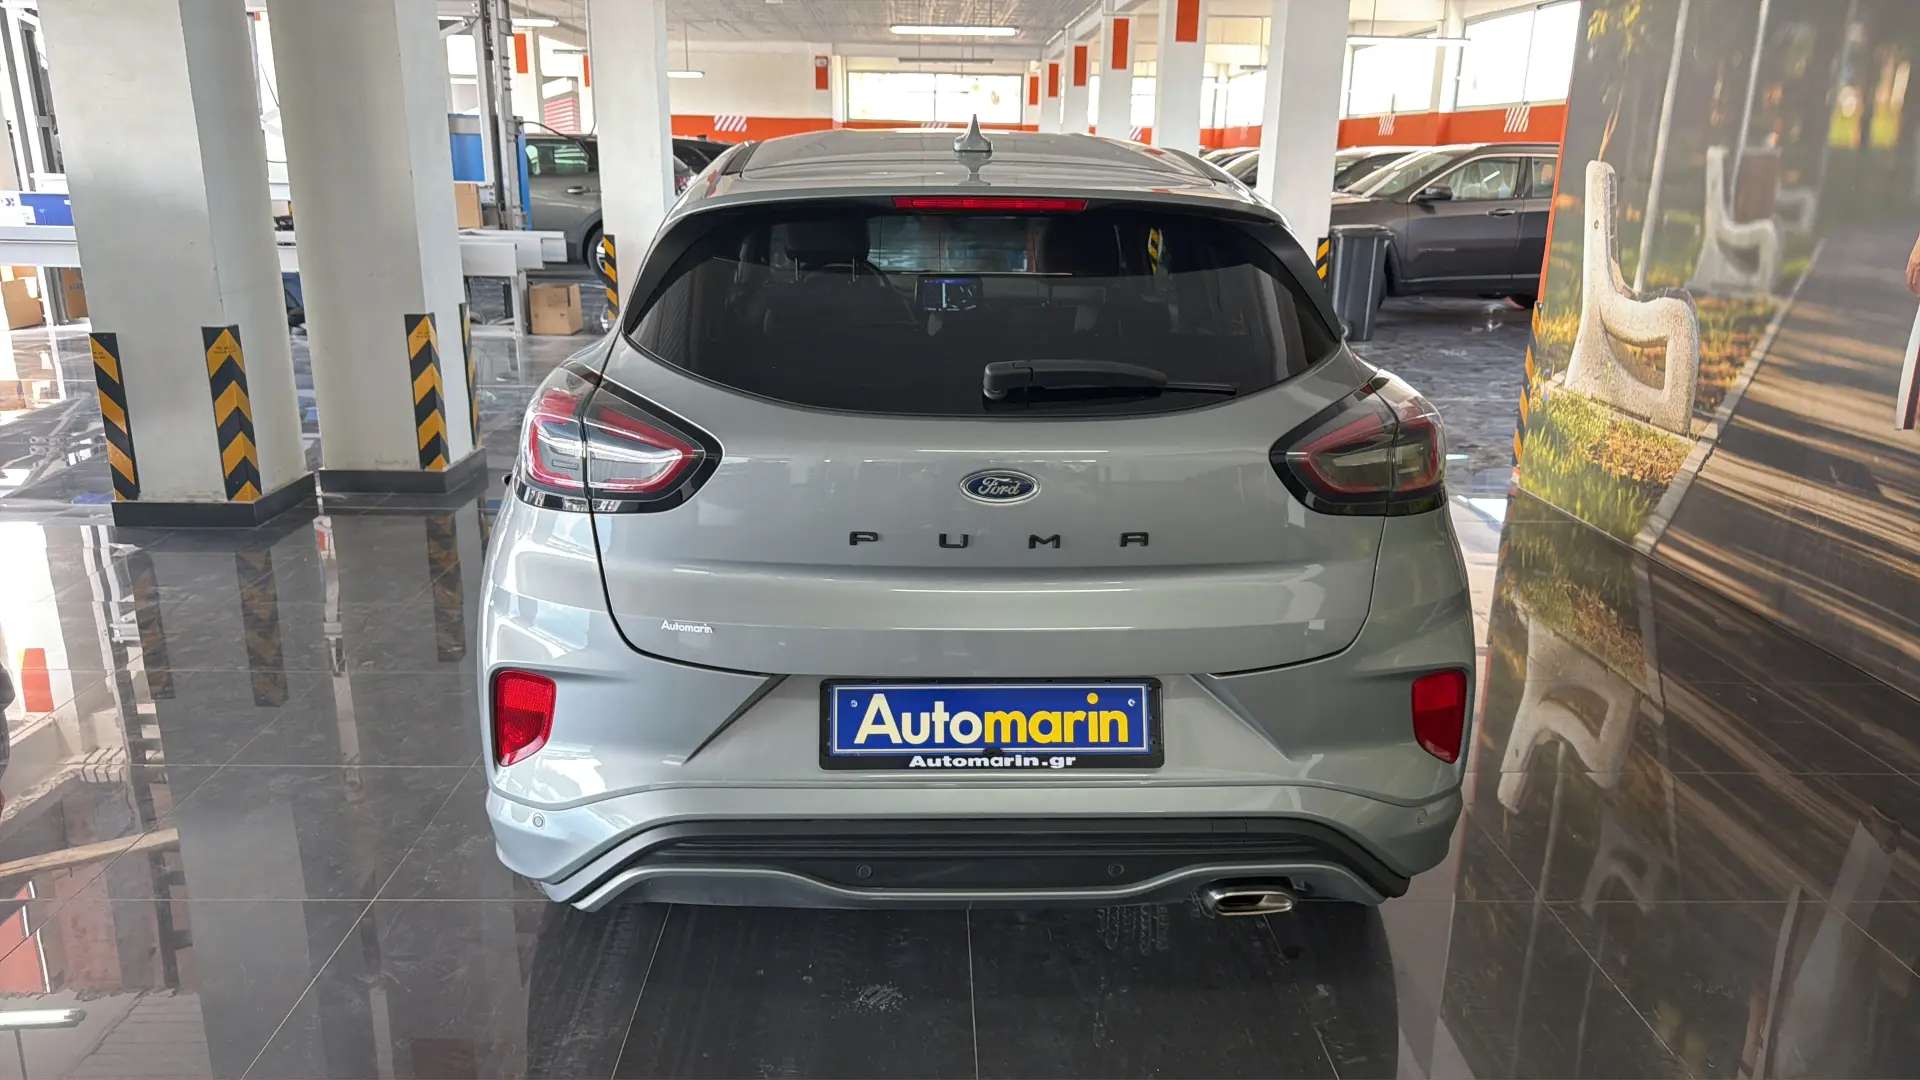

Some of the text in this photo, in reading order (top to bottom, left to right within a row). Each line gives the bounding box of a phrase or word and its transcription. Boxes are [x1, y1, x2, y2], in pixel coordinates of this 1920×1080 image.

[978, 477, 1020, 495] Ford
[849, 531, 1149, 549] PUMA
[660, 619, 713, 634] Automarin
[853, 692, 1129, 745] Automarin
[908, 755, 1077, 769] Automarin.gr
